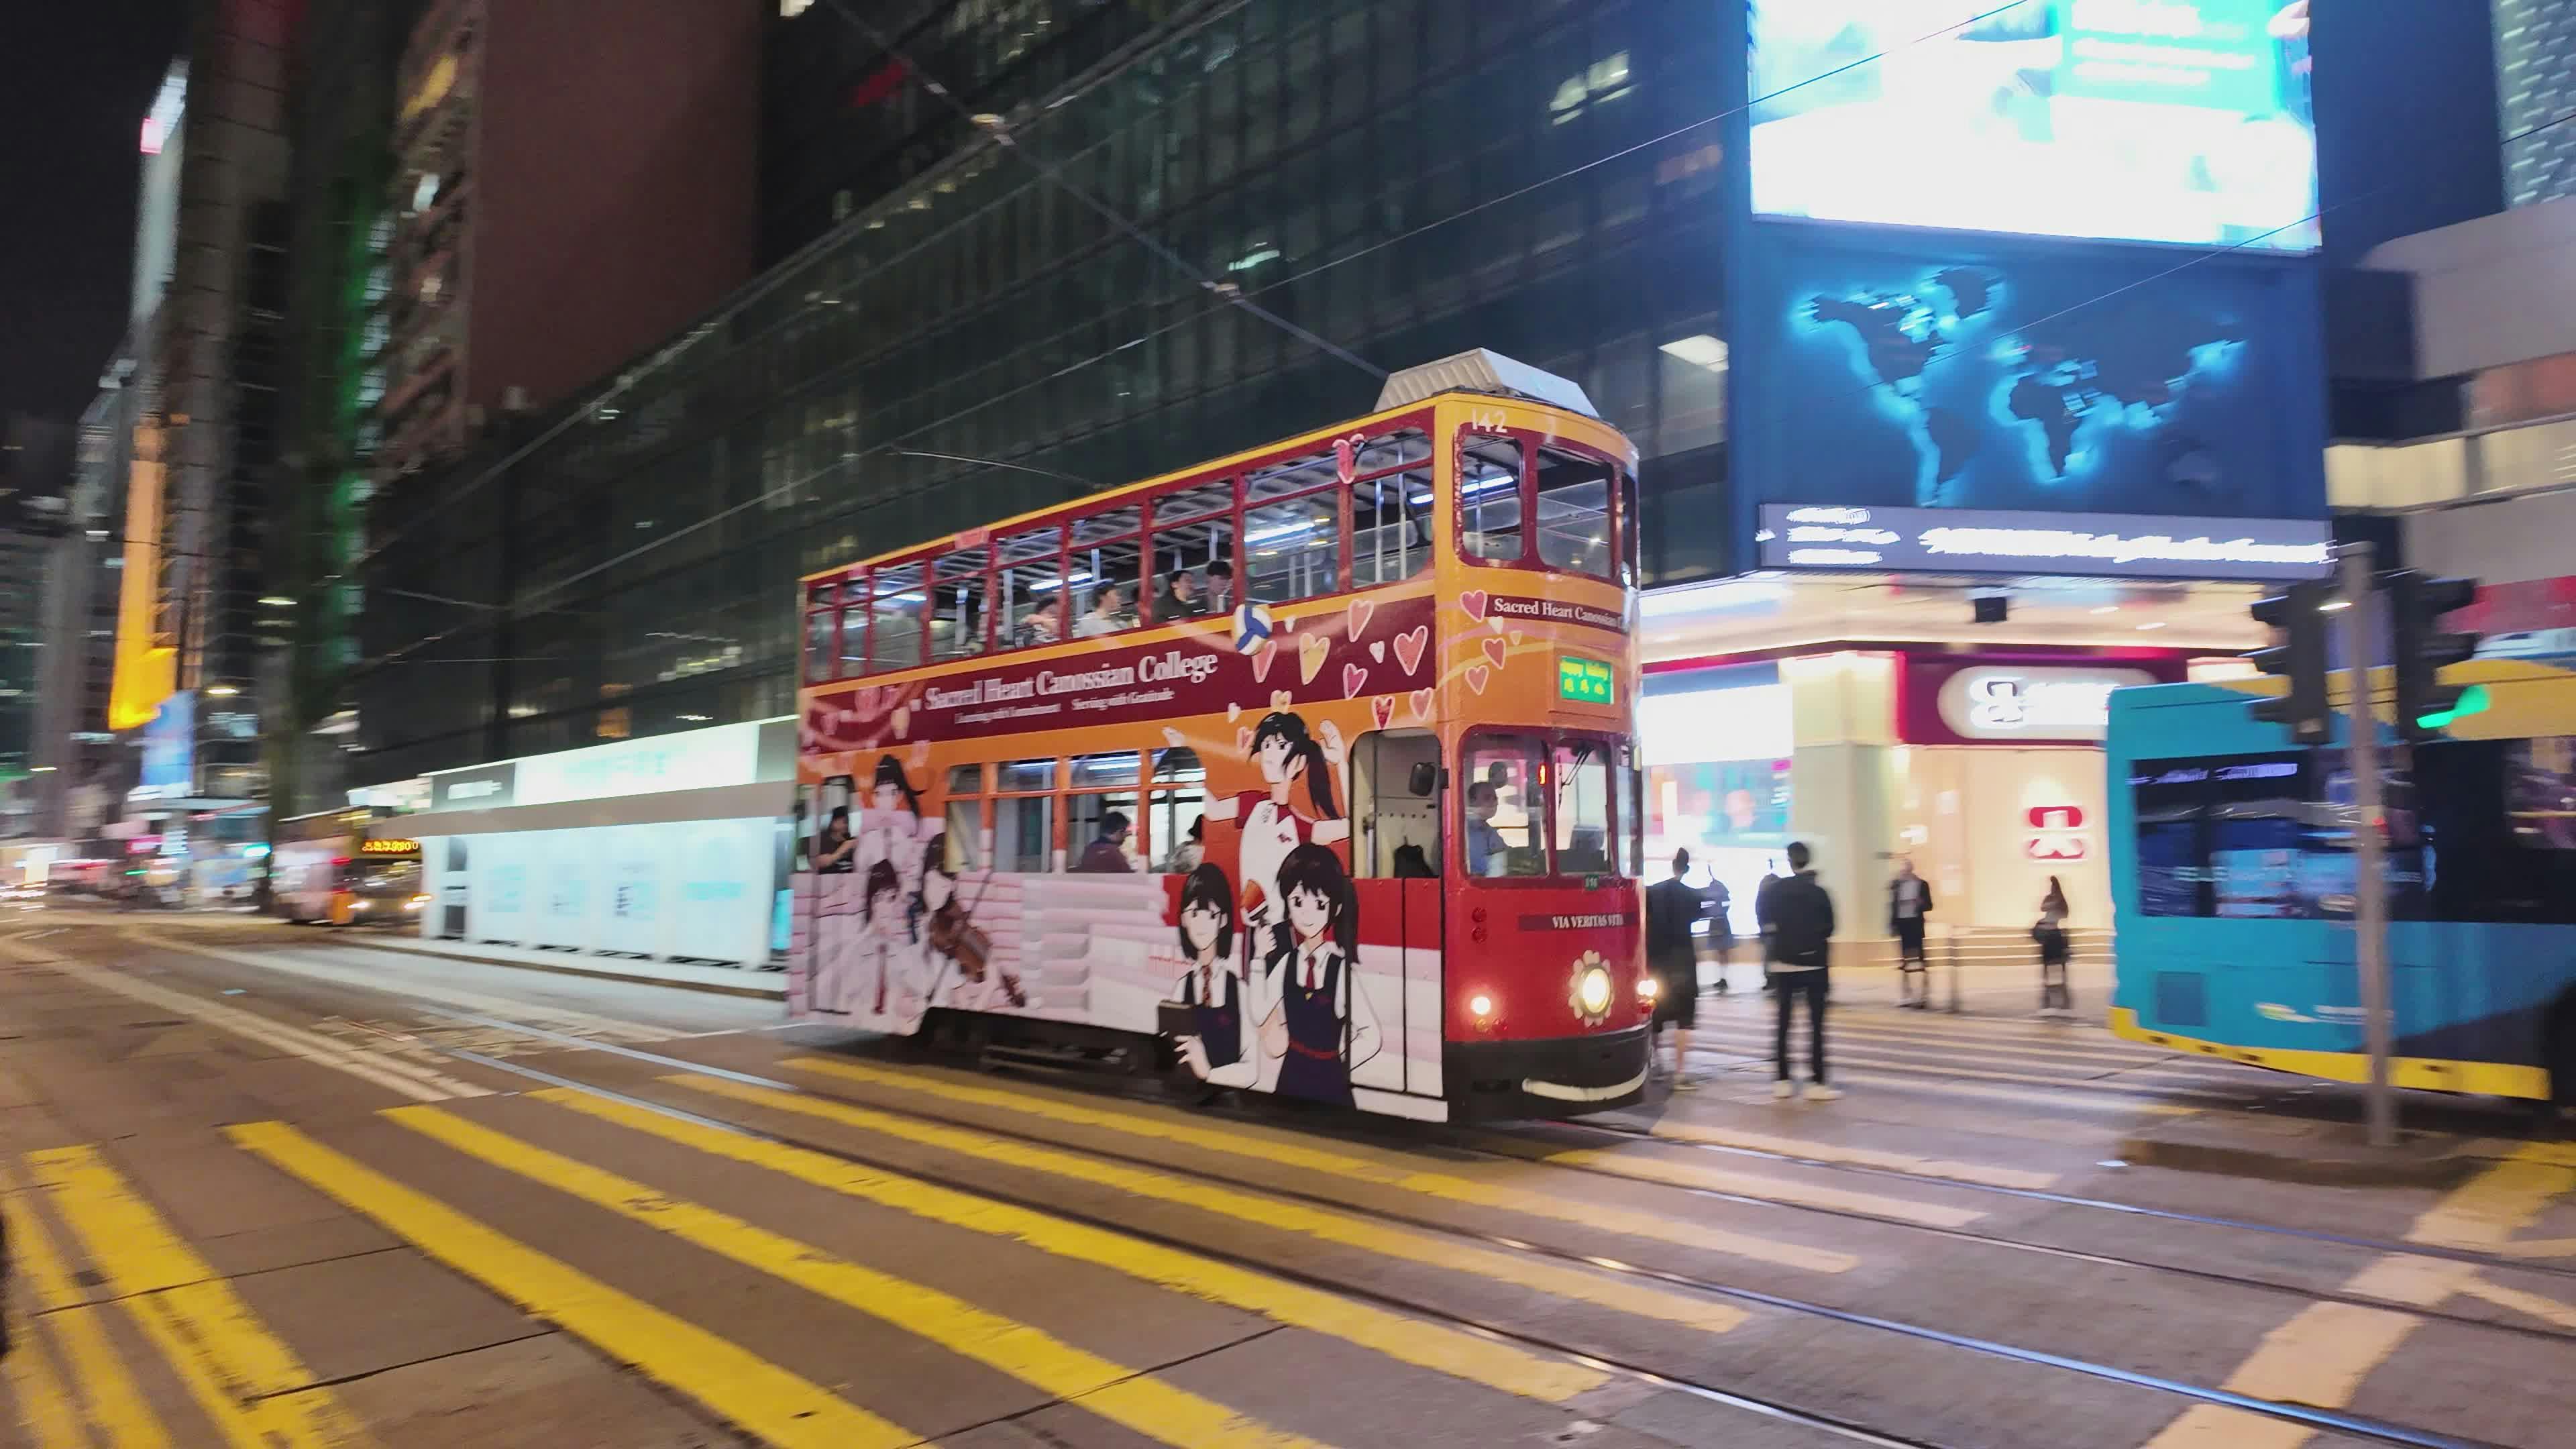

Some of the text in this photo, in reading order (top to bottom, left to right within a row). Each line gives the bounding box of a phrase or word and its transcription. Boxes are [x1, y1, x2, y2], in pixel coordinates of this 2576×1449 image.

[1472, 408, 1508, 433] 142
[1494, 598, 1540, 615] Sacred
[1542, 602, 1573, 619] Heart
[983, 676, 1036, 703] Heart
[1036, 662, 1135, 696] Canossian
[1138, 650, 1219, 684] College
[1552, 916, 1570, 929] VIA
